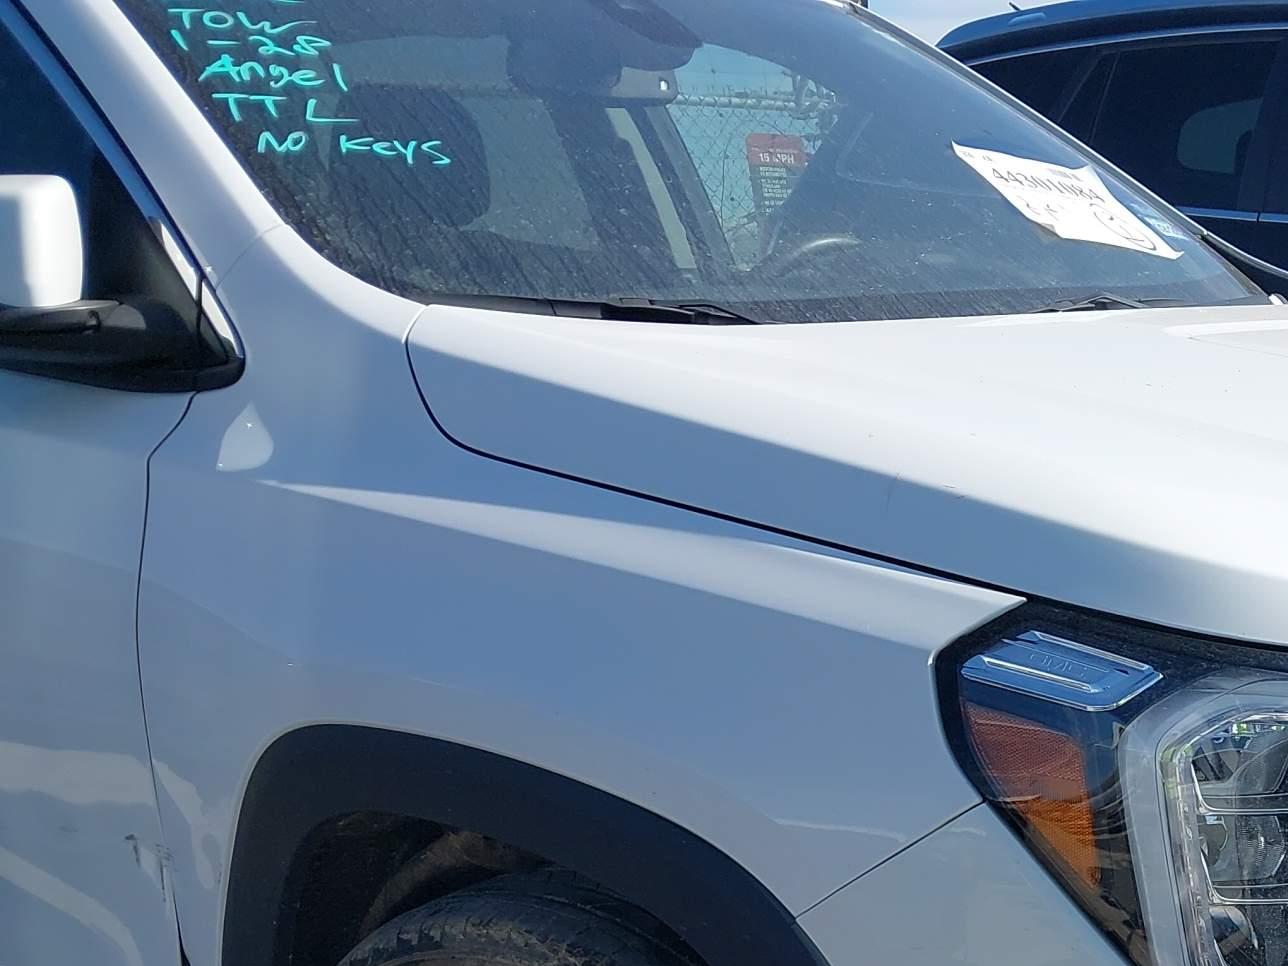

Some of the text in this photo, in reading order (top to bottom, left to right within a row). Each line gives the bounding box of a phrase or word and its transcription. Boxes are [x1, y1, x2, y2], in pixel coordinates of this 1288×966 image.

[168, 8, 317, 34] TOW
[198, 54, 349, 92] Angel
[759, 152, 770, 162] 15
